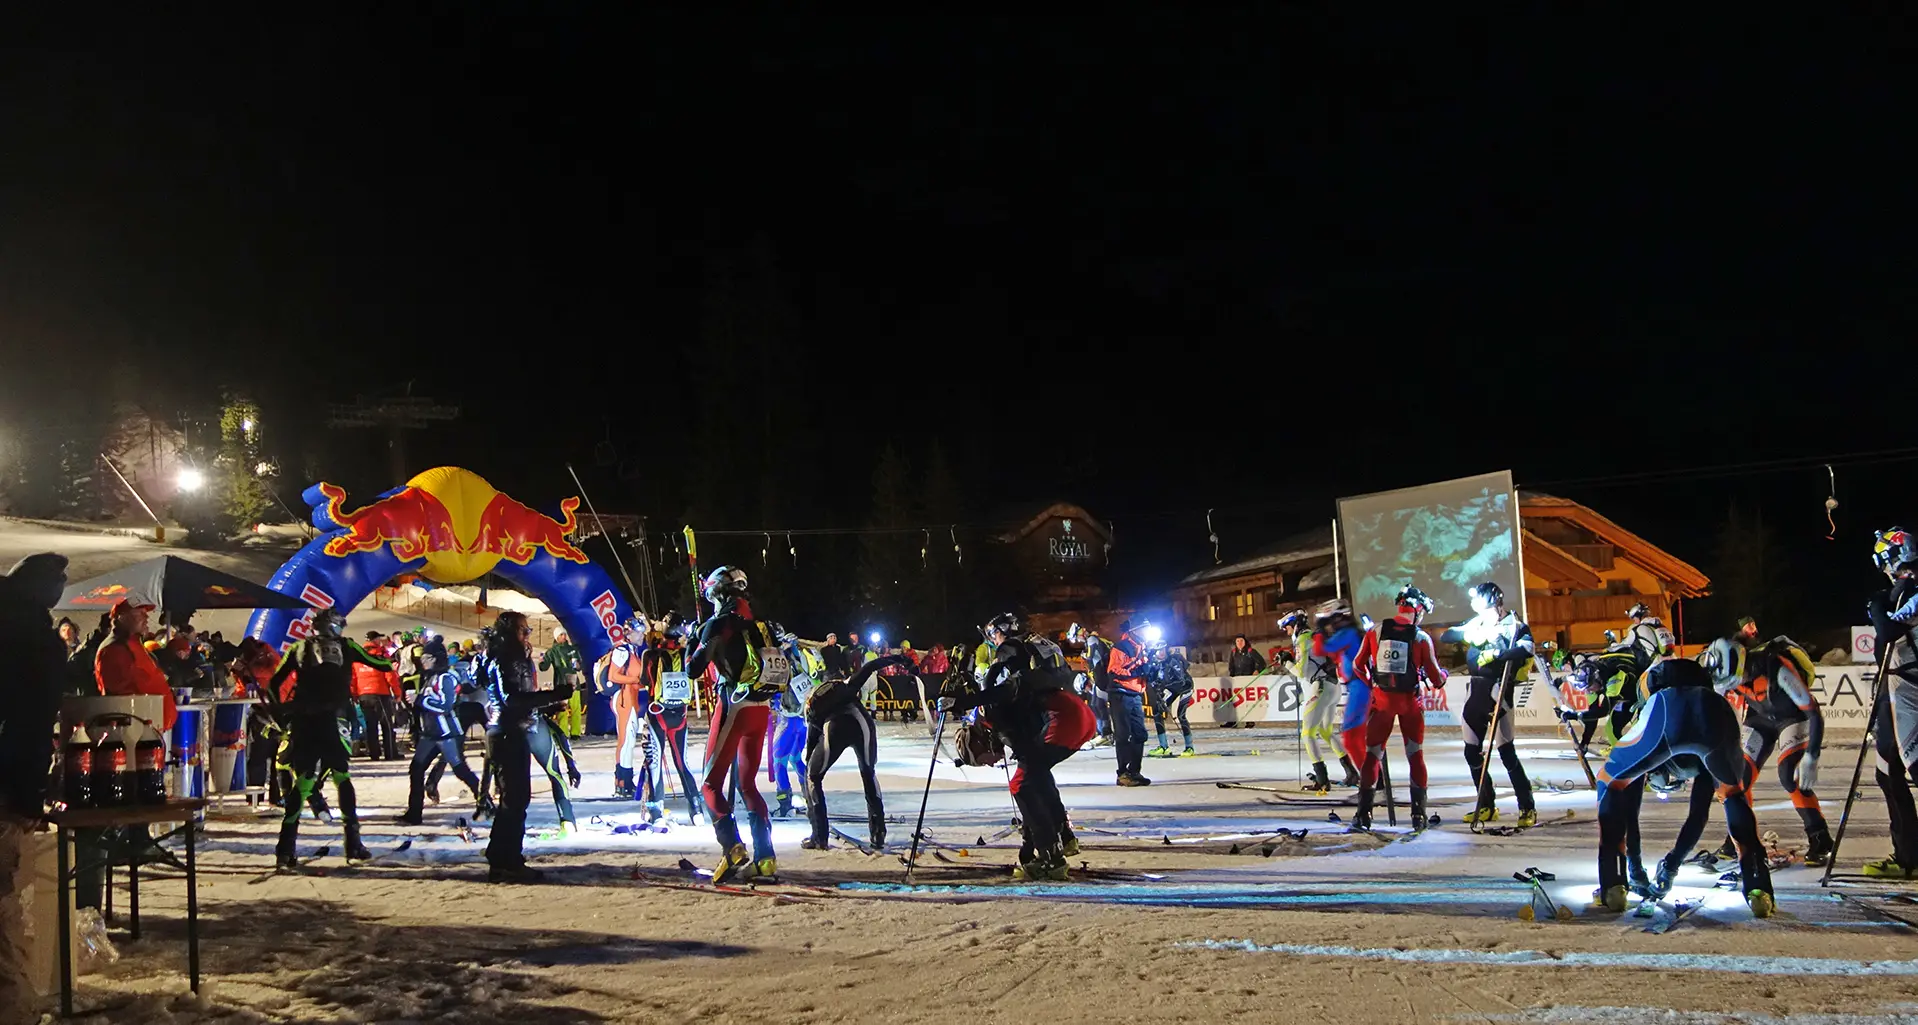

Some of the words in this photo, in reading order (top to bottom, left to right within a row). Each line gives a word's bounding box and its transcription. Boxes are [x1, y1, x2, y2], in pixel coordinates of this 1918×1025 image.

[1383, 650, 1400, 660] 80
[767, 657, 787, 669] 169
[665, 680, 687, 689] 250
[796, 679, 812, 692] 184
[865, 699, 915, 710] RTIVA
